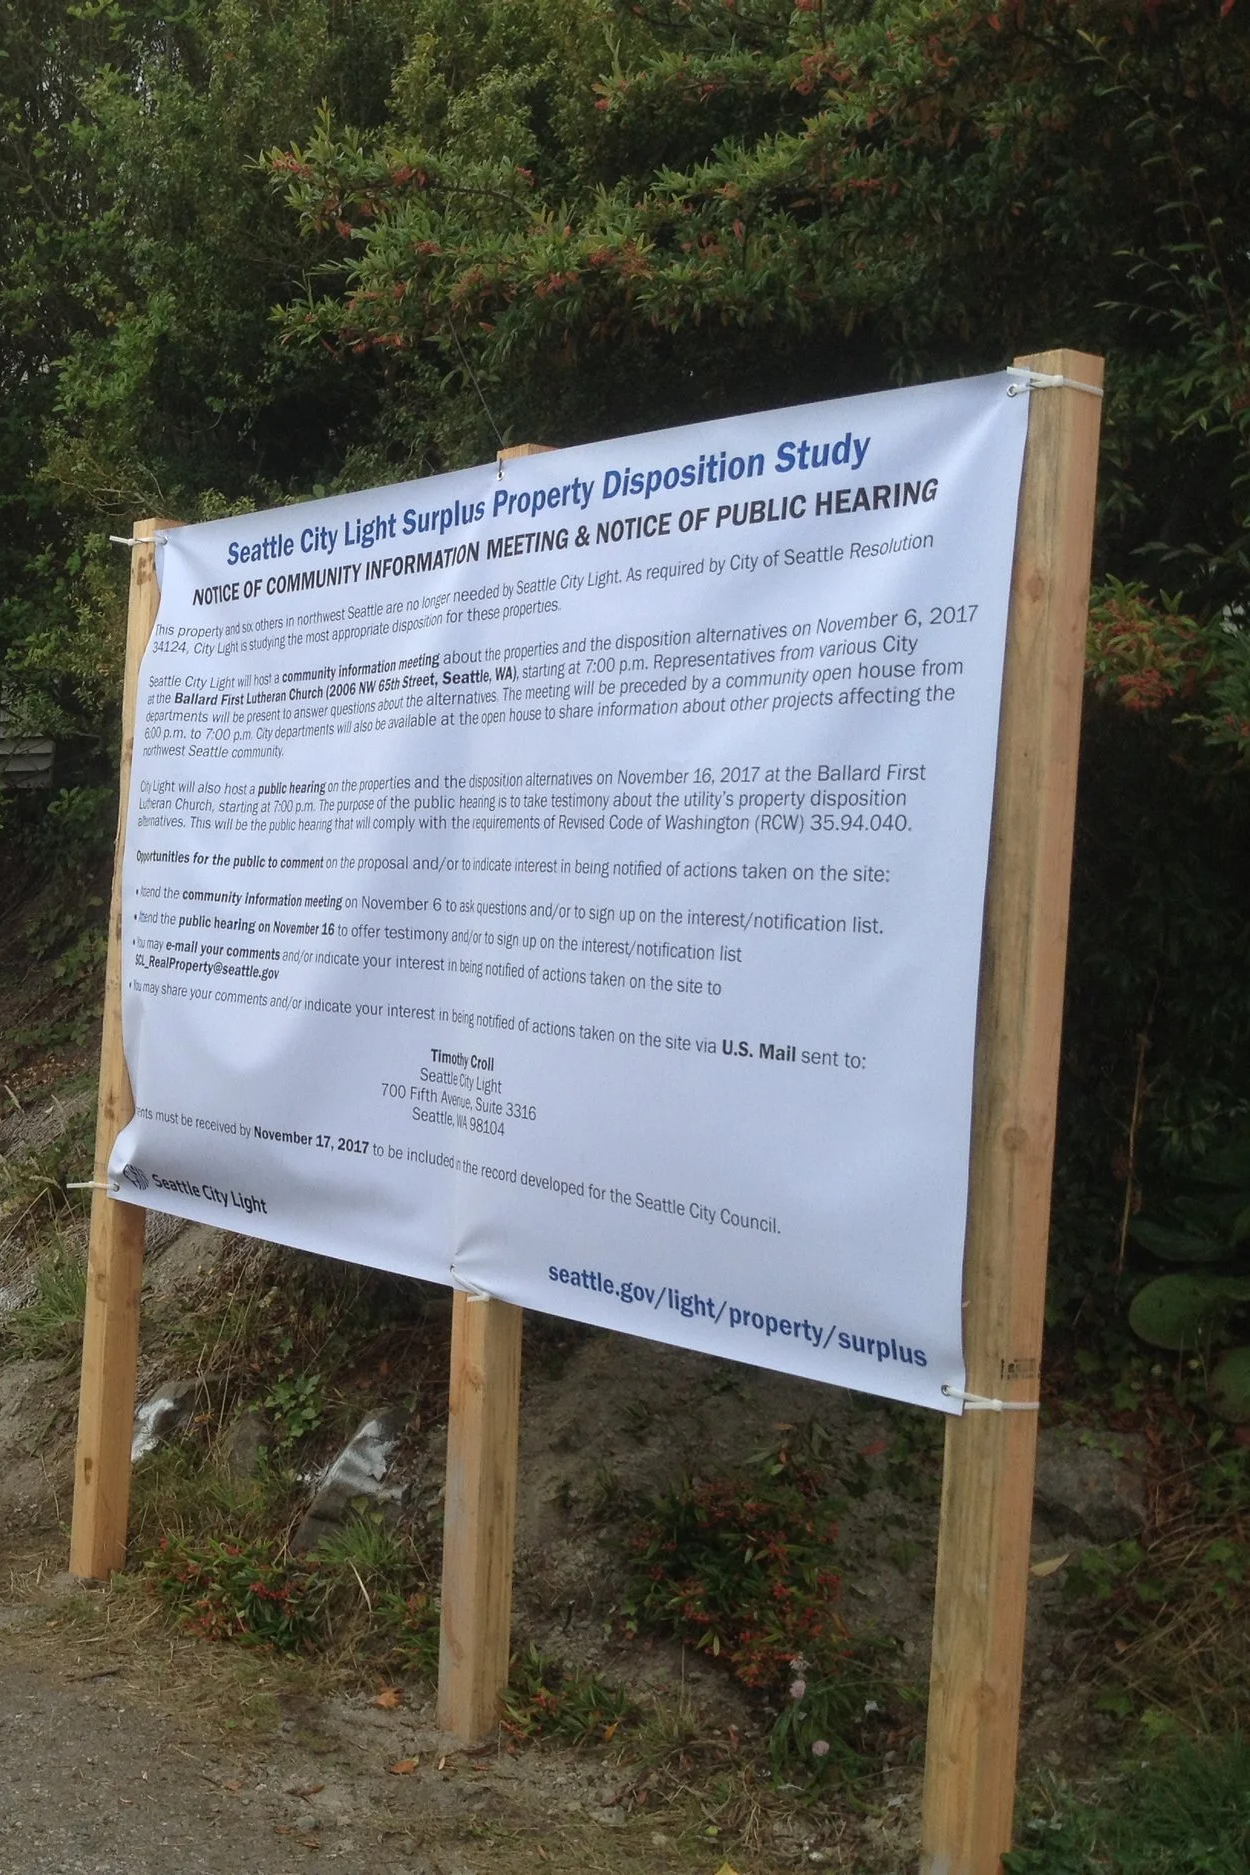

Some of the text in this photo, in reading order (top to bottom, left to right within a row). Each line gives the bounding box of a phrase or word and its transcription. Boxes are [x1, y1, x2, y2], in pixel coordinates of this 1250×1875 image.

[227, 431, 871, 566] Seattle City Light Surplus Property Disposition Study
[193, 477, 938, 606] NOTICE OF COMMUNITY INFORMATION MEETING & NOTICE OF PUBLIC HEARING
[177, 534, 933, 640] property northwest Seattle needed Seattle required Seattle Resolution
[152, 600, 561, 654] 34124, studying appropriate disposition these properties.
[282, 604, 978, 684] community information meeting about properties disposition alternatives November 2017
[175, 639, 876, 706] Ballard Lutheran Street, Seattle, starting Representatives various
[330, 658, 963, 719] questions meeting preceded community open house from
[275, 686, 921, 740] departments available information about other projects affecting
[188, 744, 282, 759] Seattle community.
[289, 764, 926, 796] hearing properties disposition alternatives November 2017 Ballard First
[175, 788, 906, 817] Church, starting purpose public testimony about property disposition
[373, 814, 911, 834] comply requirements Revised Washington (RCW) 35.94.040.
[280, 856, 889, 883] comment proposal and/or indicate interest notified actions taken site:
[183, 890, 846, 932] community information meeting November questions and/or interest/notification
[178, 914, 714, 961] public hearing November offer testimony interest/notification
[135, 953, 279, 982] SCL_RealProperty@seattle.gov
[227, 946, 625, 987] comments indicate interest notified actions taken
[215, 990, 838, 1067] comments indicate interest notified actions Mail sent
[431, 1048, 494, 1071] Timothy Croll
[382, 1082, 536, 1121] 700 Fifth Avenue, Suite 3316
[420, 1067, 502, 1096] Seattle City Light
[413, 1106, 454, 1128] Seattle,
[470, 1116, 504, 1137] 98104
[152, 1173, 267, 1215] Seattle City Light
[196, 1118, 780, 1234] received November included record developed Seattle Council.
[549, 1266, 927, 1368] seattle.gov/light/property/surplus
